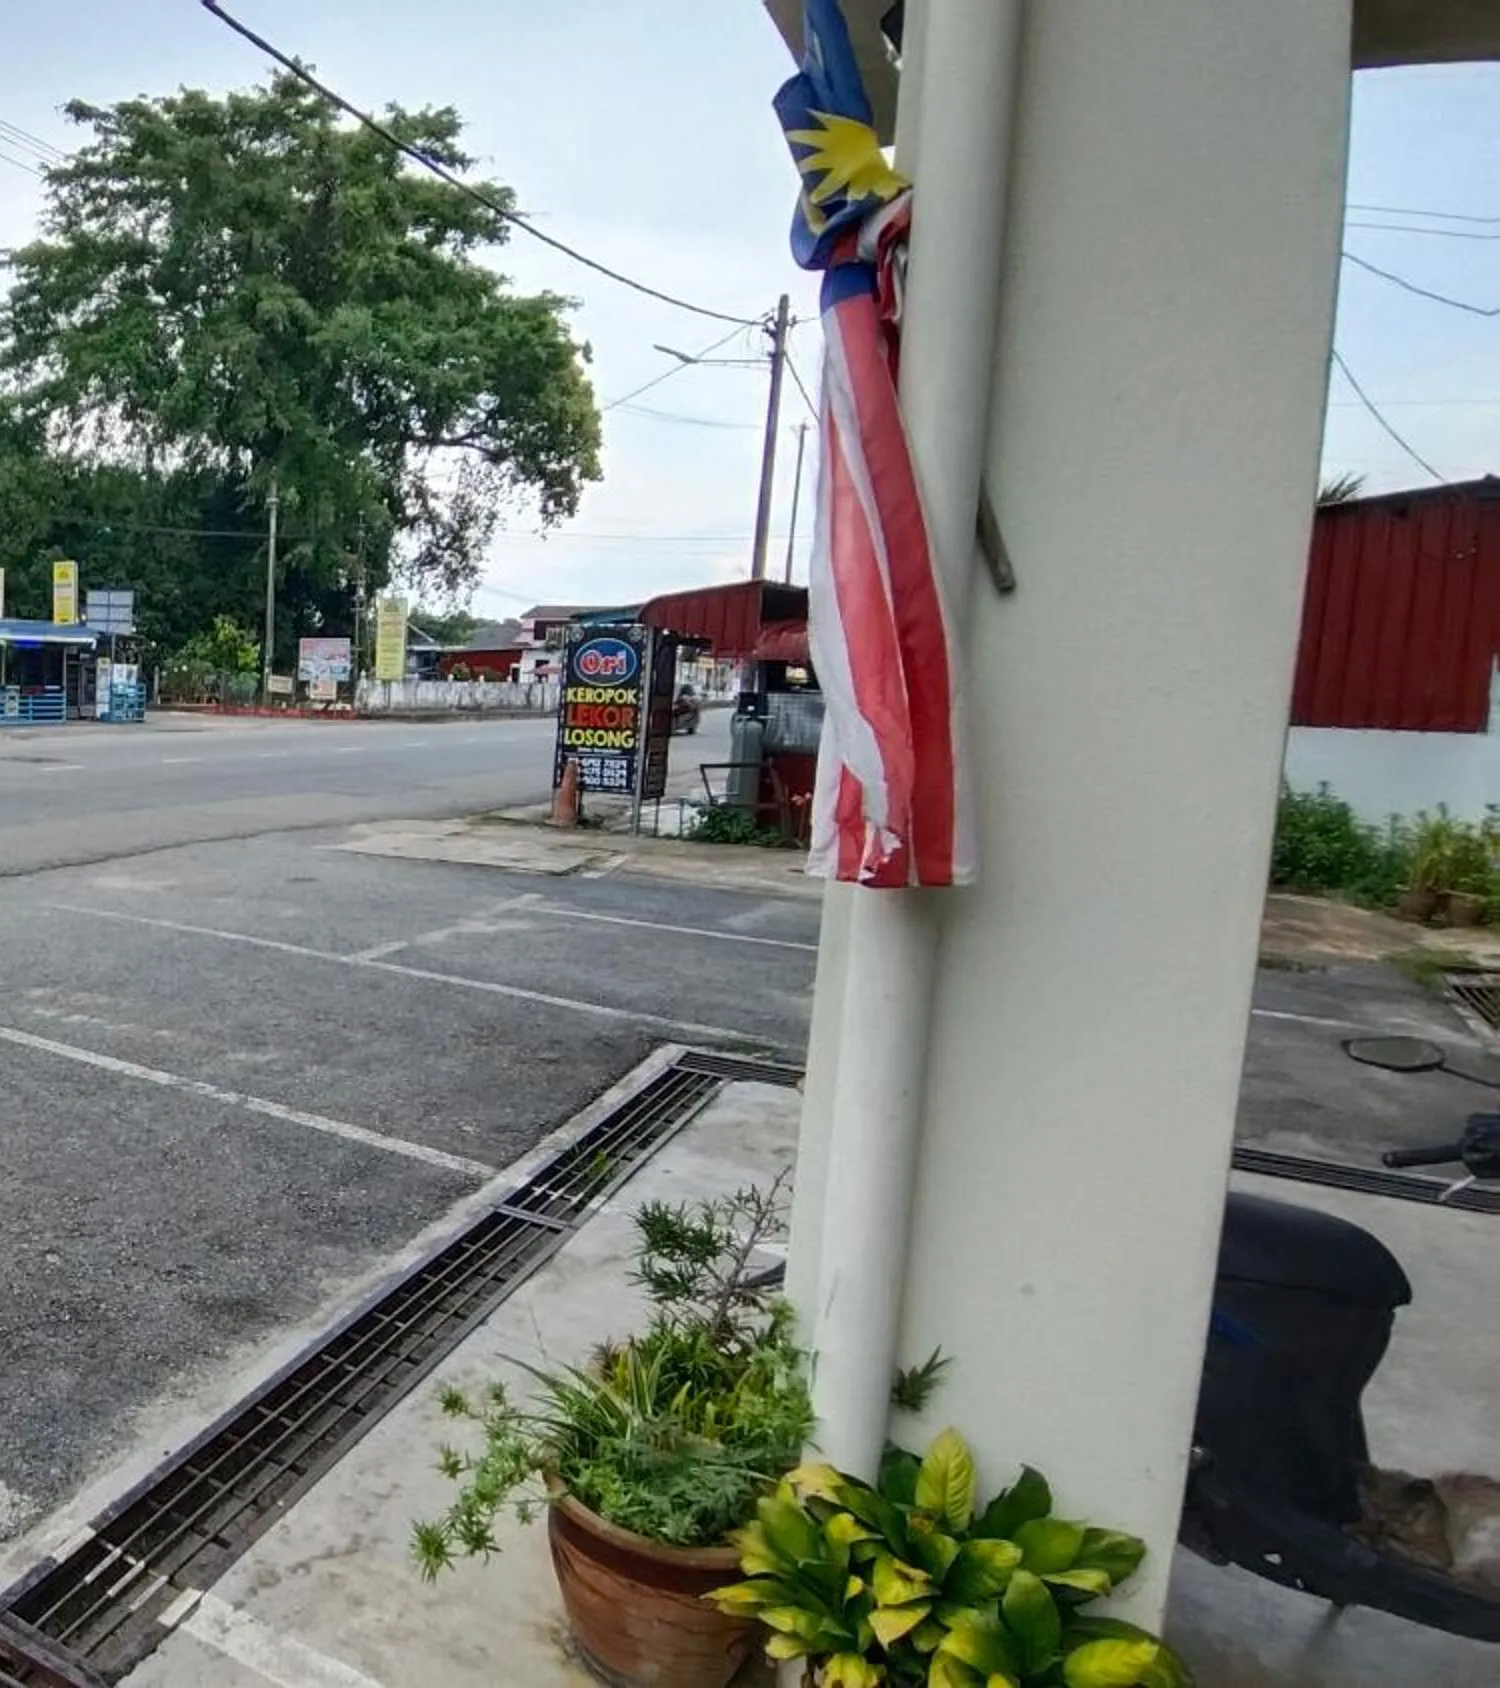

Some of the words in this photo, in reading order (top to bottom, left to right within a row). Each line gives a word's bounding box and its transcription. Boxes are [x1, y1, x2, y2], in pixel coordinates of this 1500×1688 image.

[579, 649, 627, 675] Ori
[566, 687, 637, 704] KEROPOK
[566, 704, 636, 728] LEKOR
[564, 728, 635, 748] LOSONG
